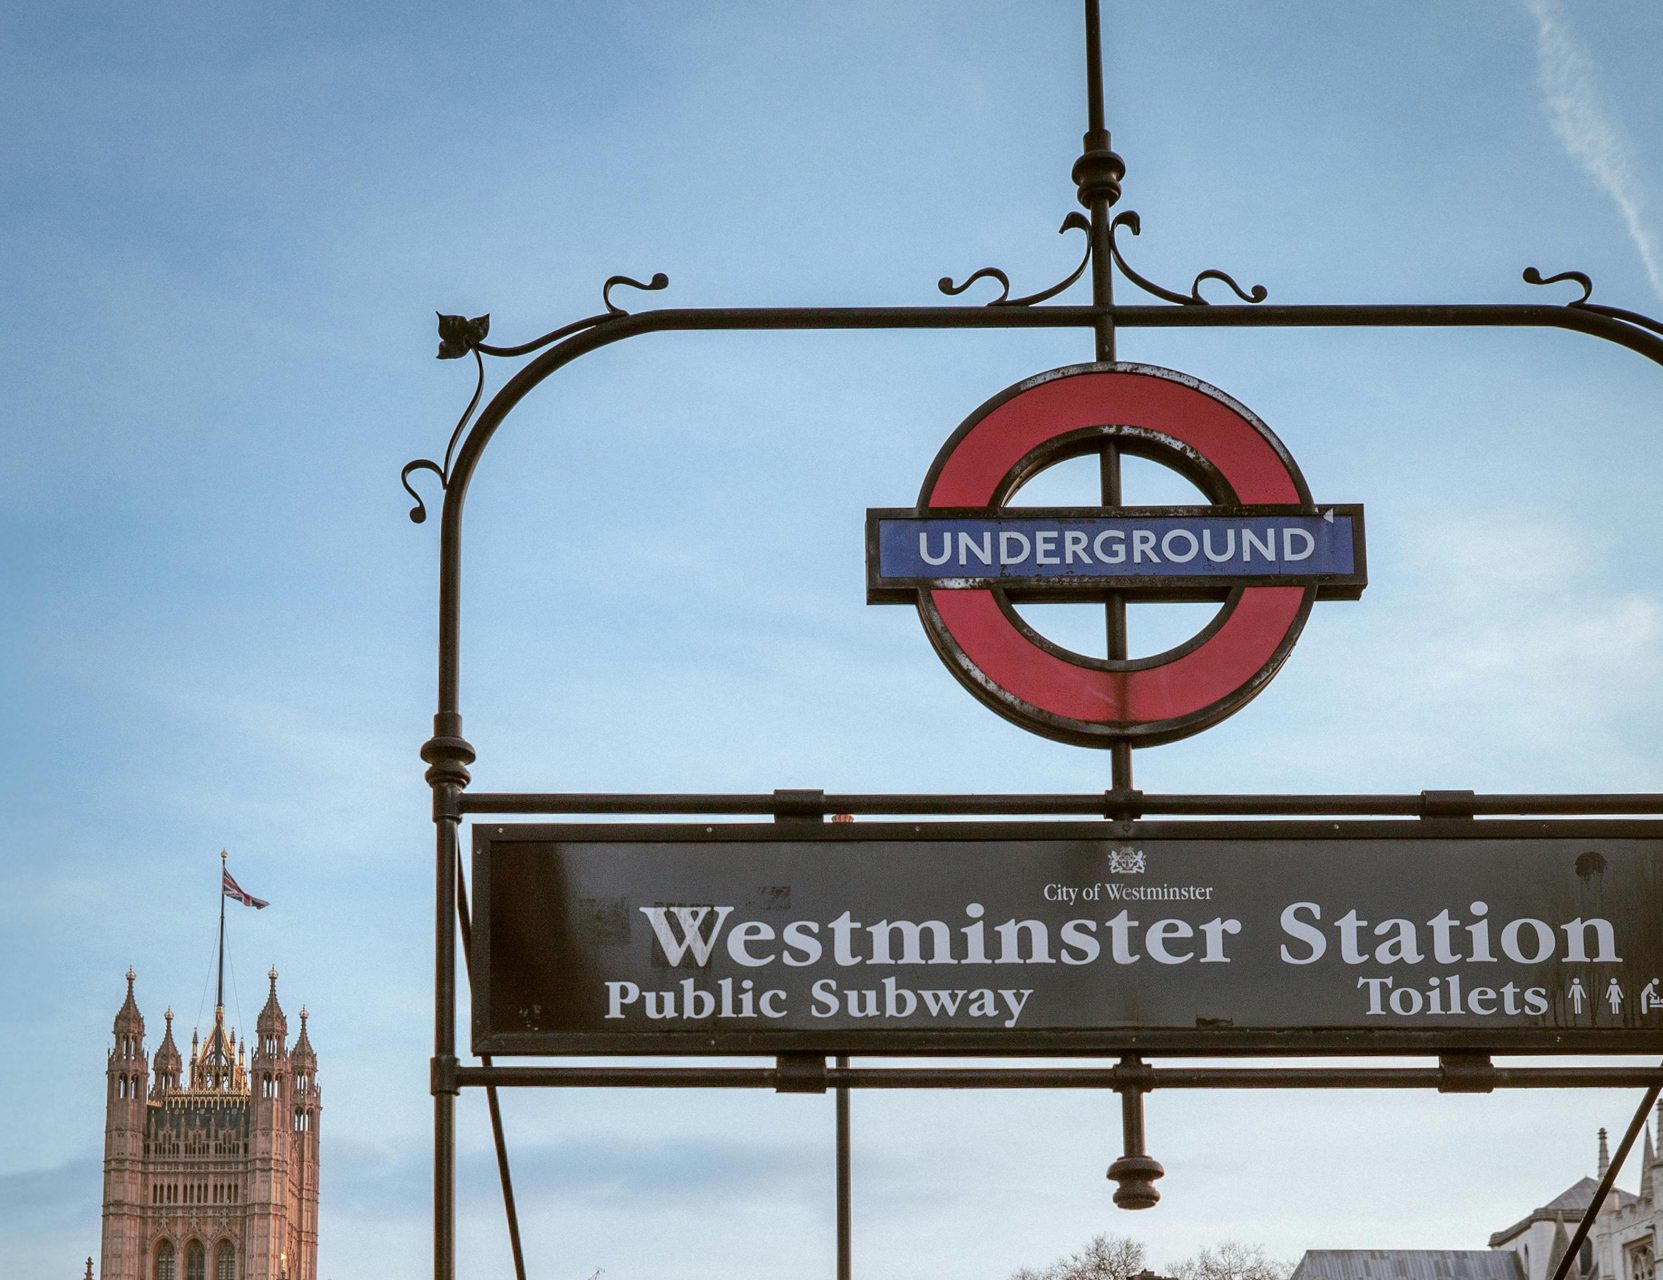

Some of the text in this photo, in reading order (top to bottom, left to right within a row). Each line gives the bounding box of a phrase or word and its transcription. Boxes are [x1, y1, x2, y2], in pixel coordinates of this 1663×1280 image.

[918, 527, 1316, 566] UNDERGROUND
[1043, 882, 1213, 906] City of Westminster
[639, 900, 1623, 967] Westminster Station
[604, 974, 1549, 1028] Public Subway Toilets
